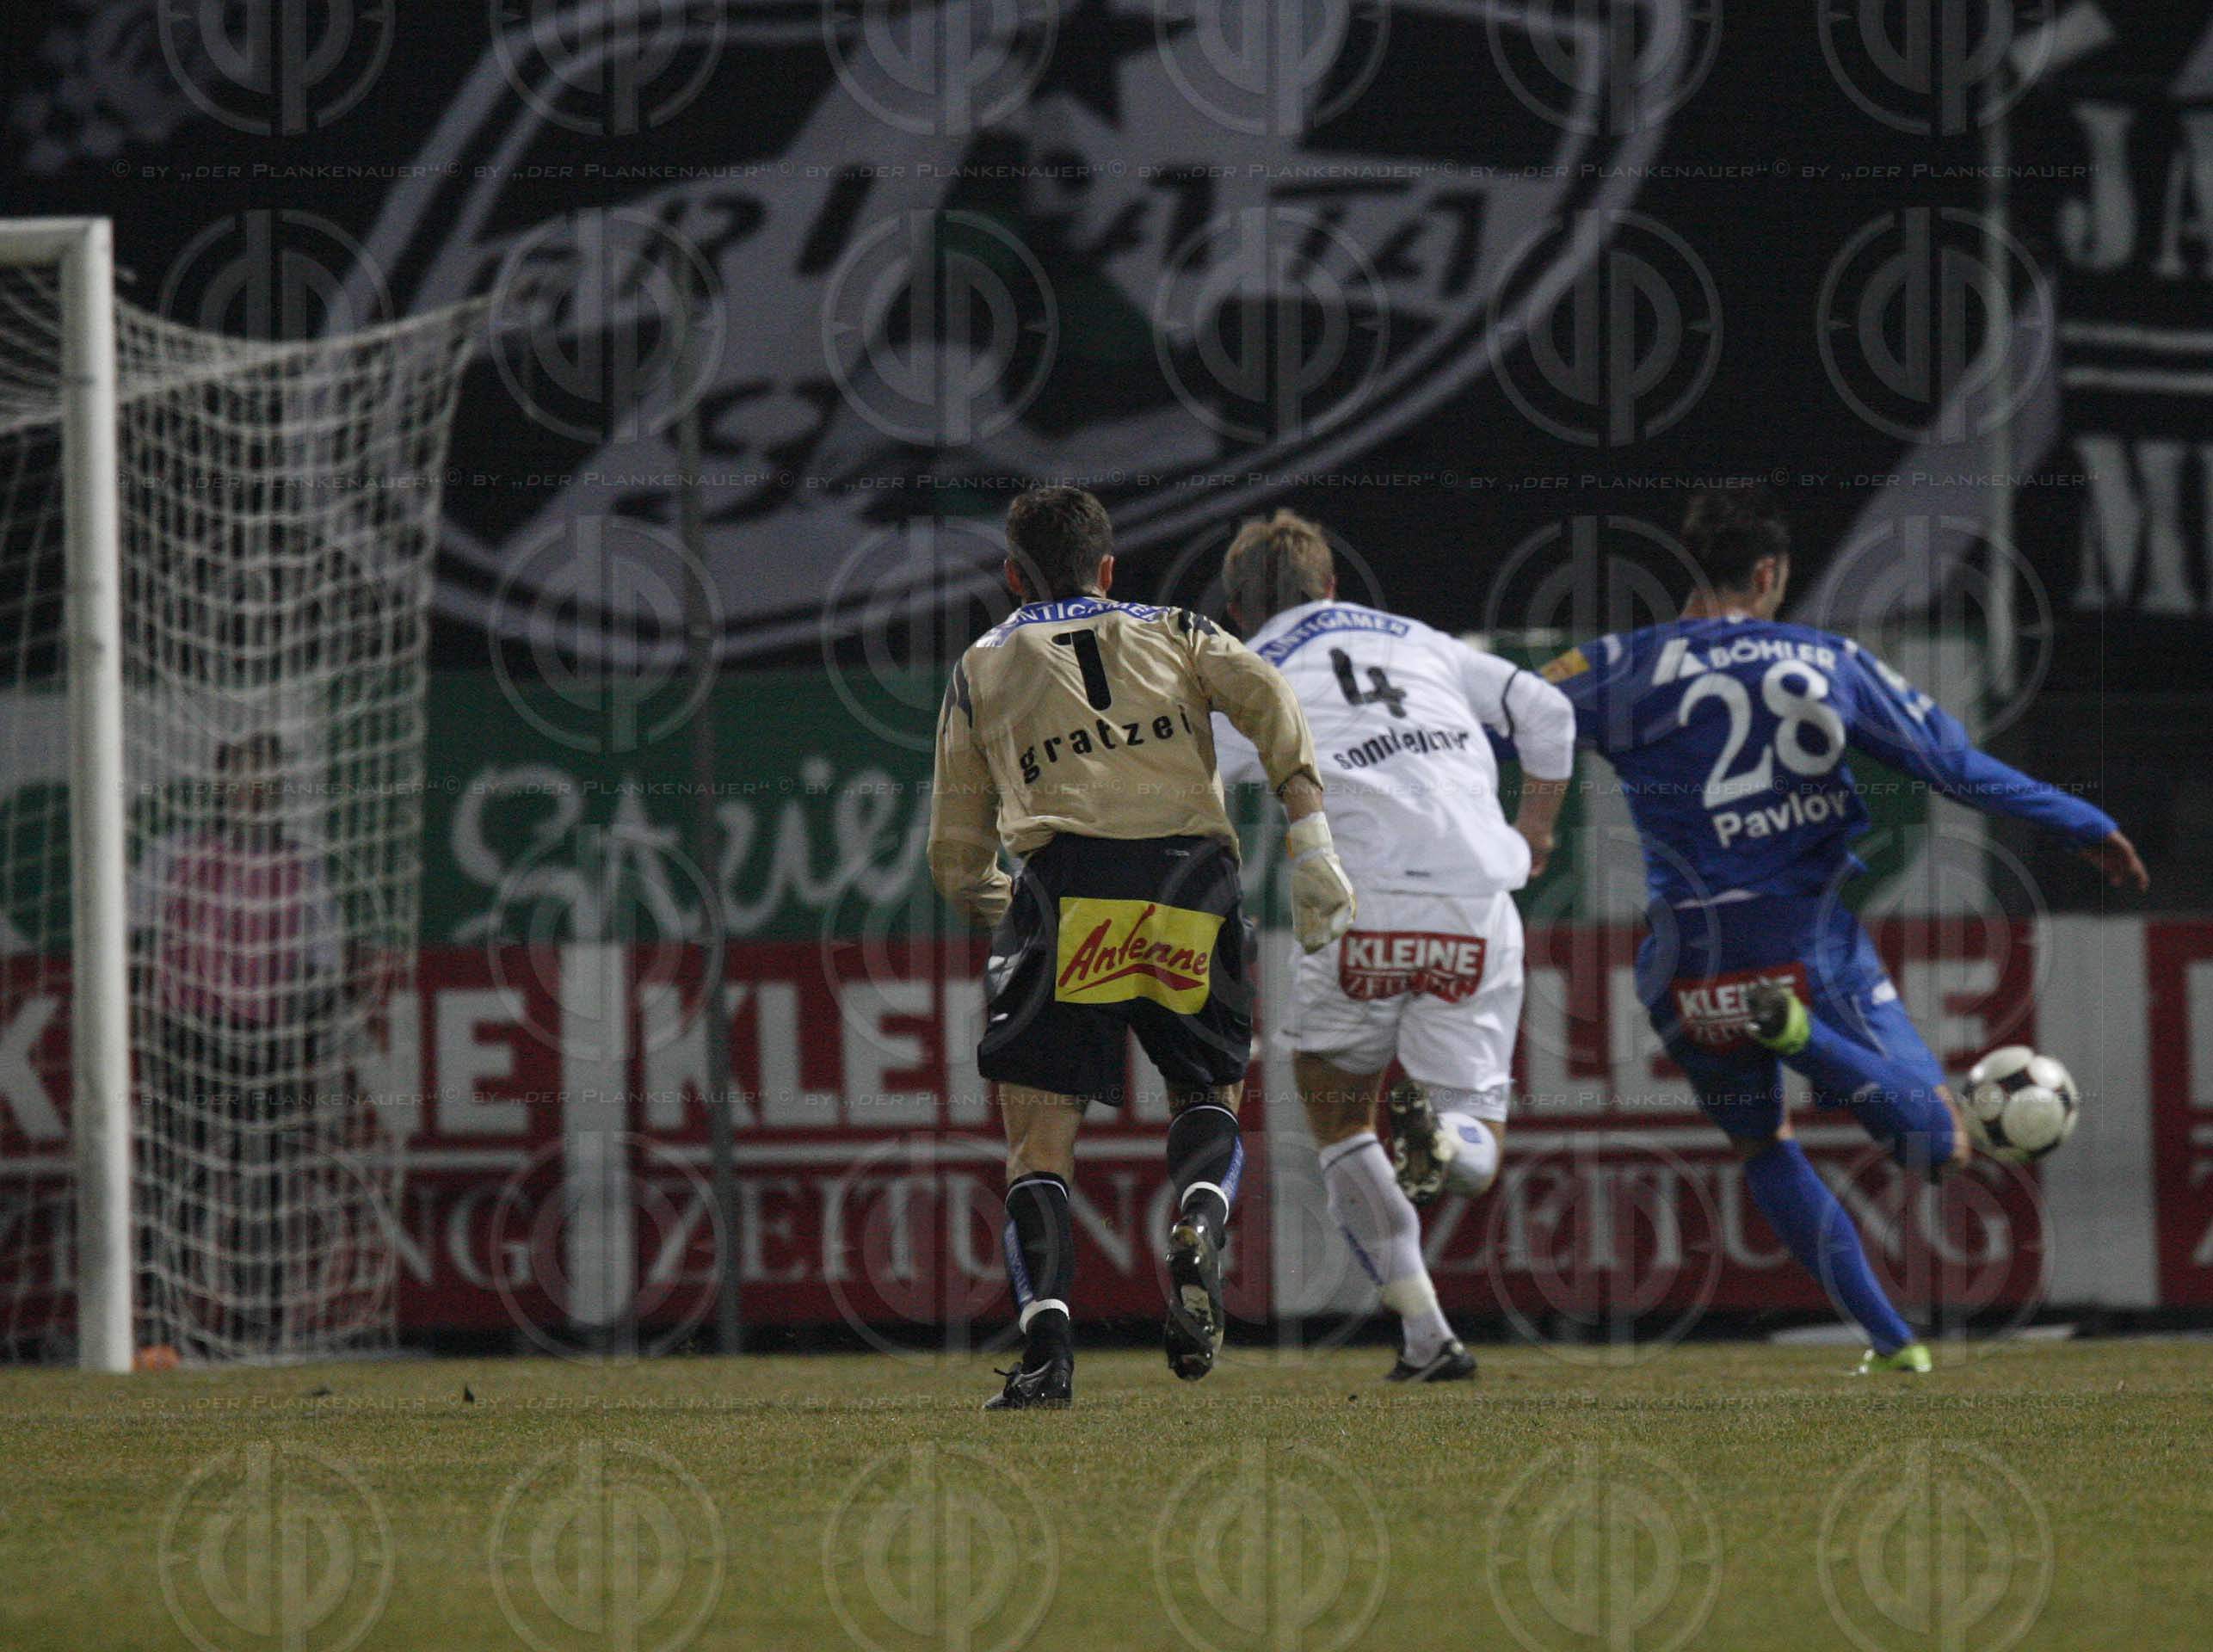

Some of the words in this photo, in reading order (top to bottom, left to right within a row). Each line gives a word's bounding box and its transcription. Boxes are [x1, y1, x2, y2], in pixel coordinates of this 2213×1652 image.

[1051, 628, 1112, 712] 1
[1329, 647, 1408, 719] 4
[1708, 639, 1836, 670] BÖHLER
[1678, 659, 1847, 809] 28
[1712, 790, 1850, 848] Pavlov
[1057, 903, 1208, 988] Antenne
[1347, 936, 1481, 976] KLEINE
[1679, 974, 1797, 1019] KLEI
